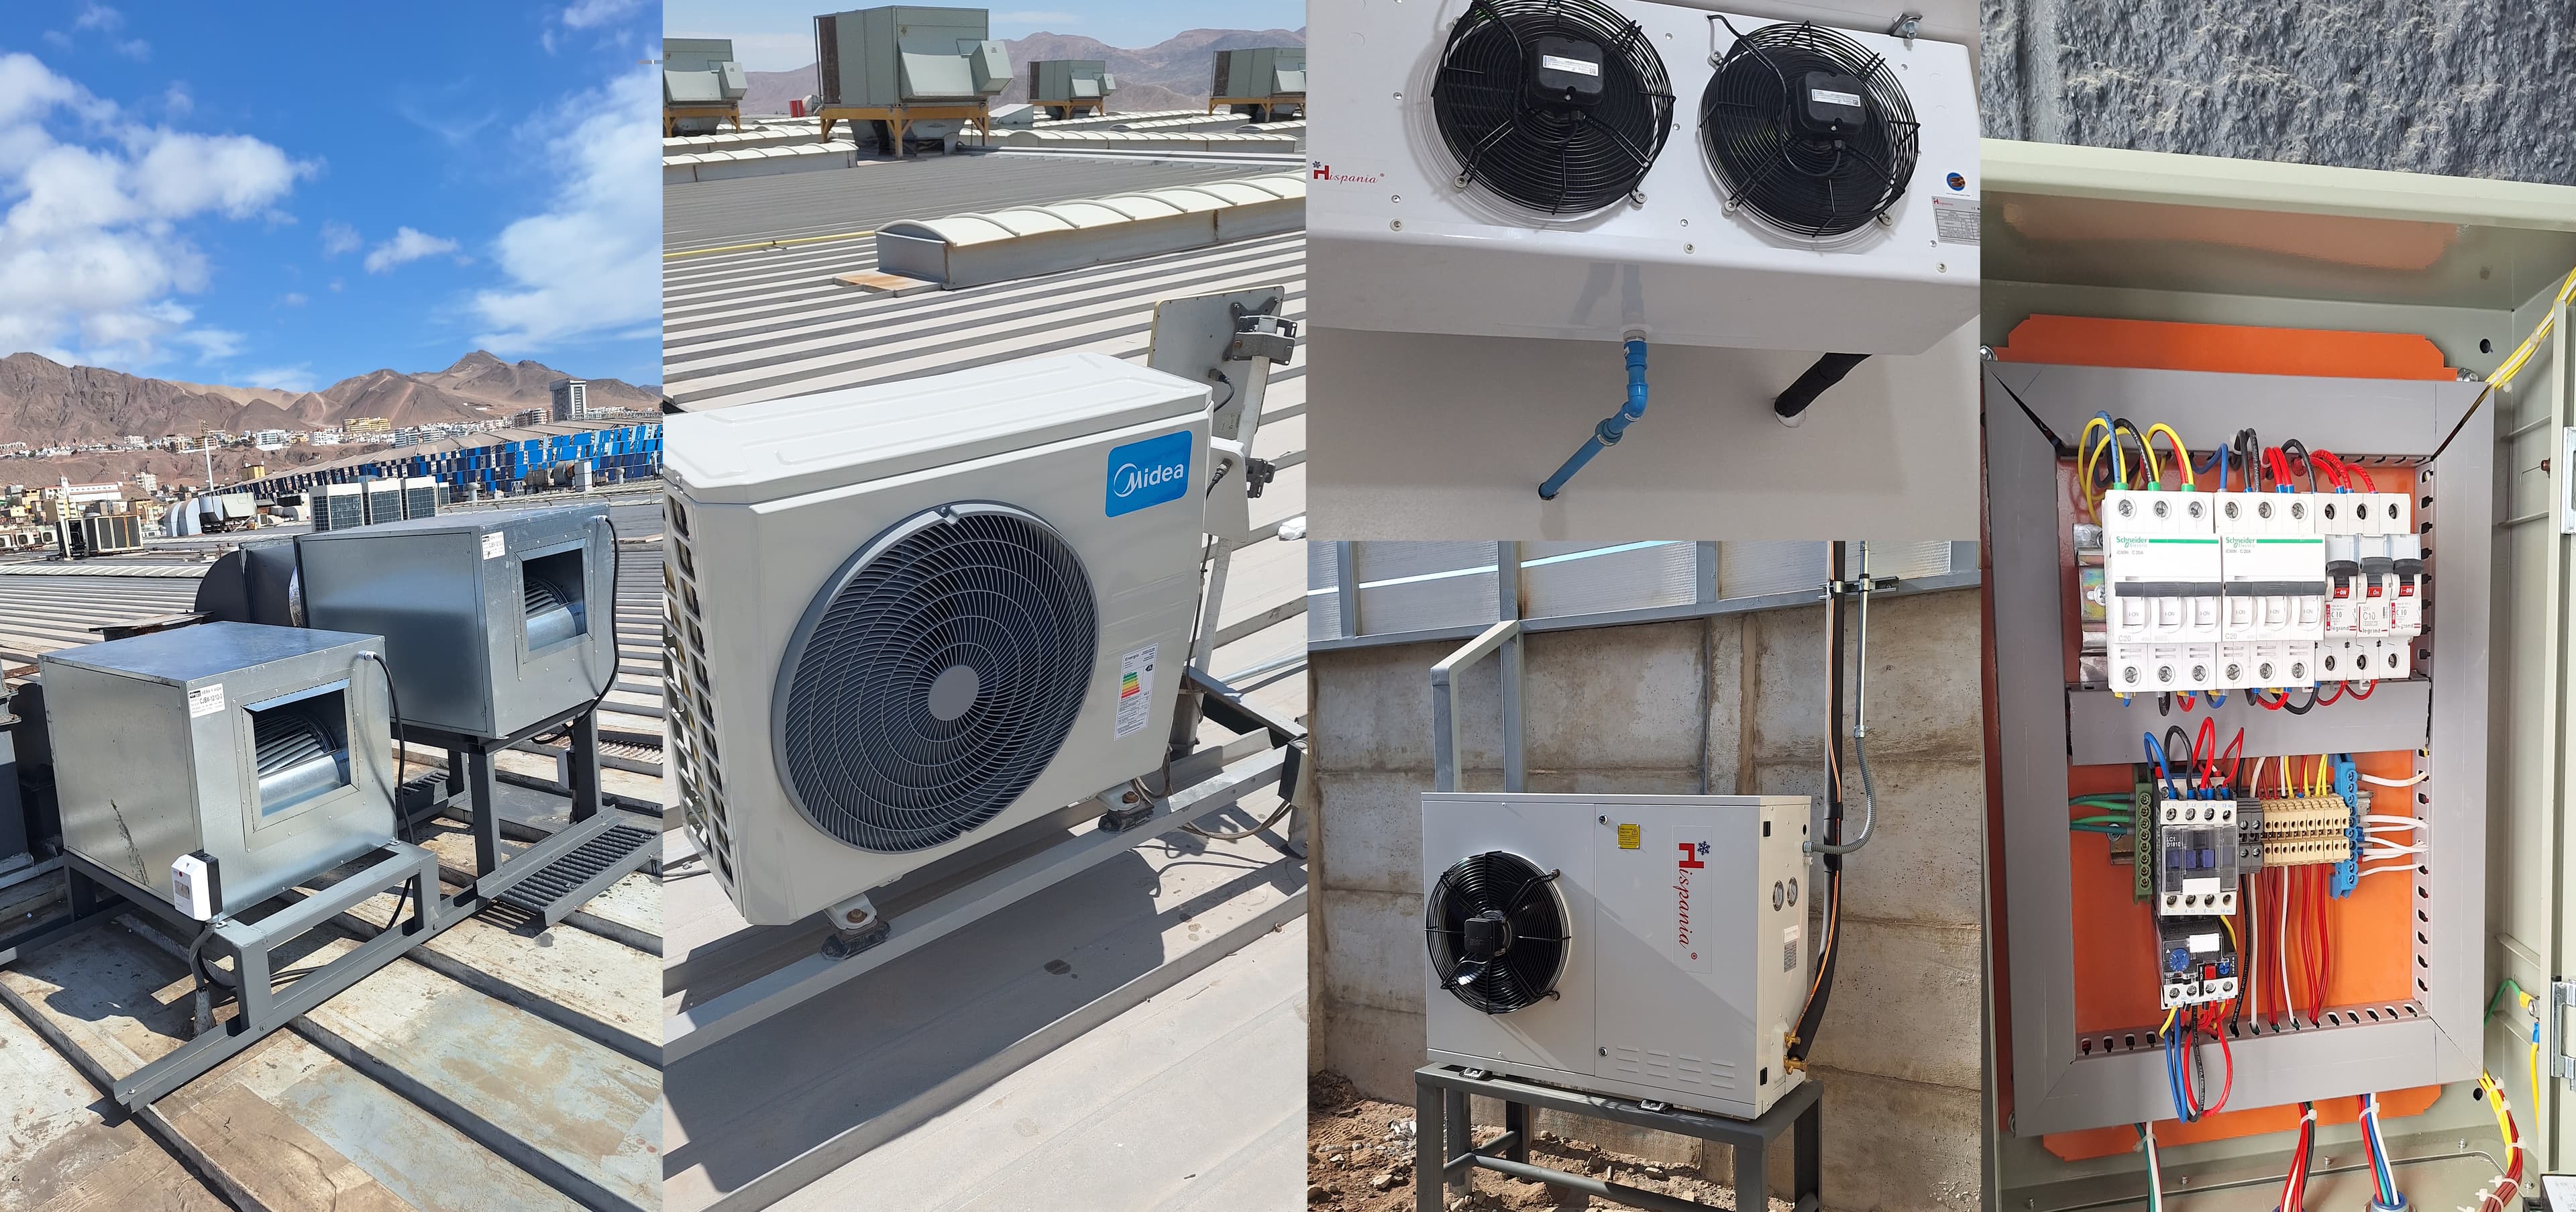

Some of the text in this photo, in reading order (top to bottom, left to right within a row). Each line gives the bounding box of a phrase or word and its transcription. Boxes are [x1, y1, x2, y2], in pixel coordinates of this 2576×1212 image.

[1313, 164, 1378, 185] Hispania
[1114, 463, 1184, 497] Midea
[2363, 611, 2376, 620] C10
[1673, 843, 1705, 950] Hispania
